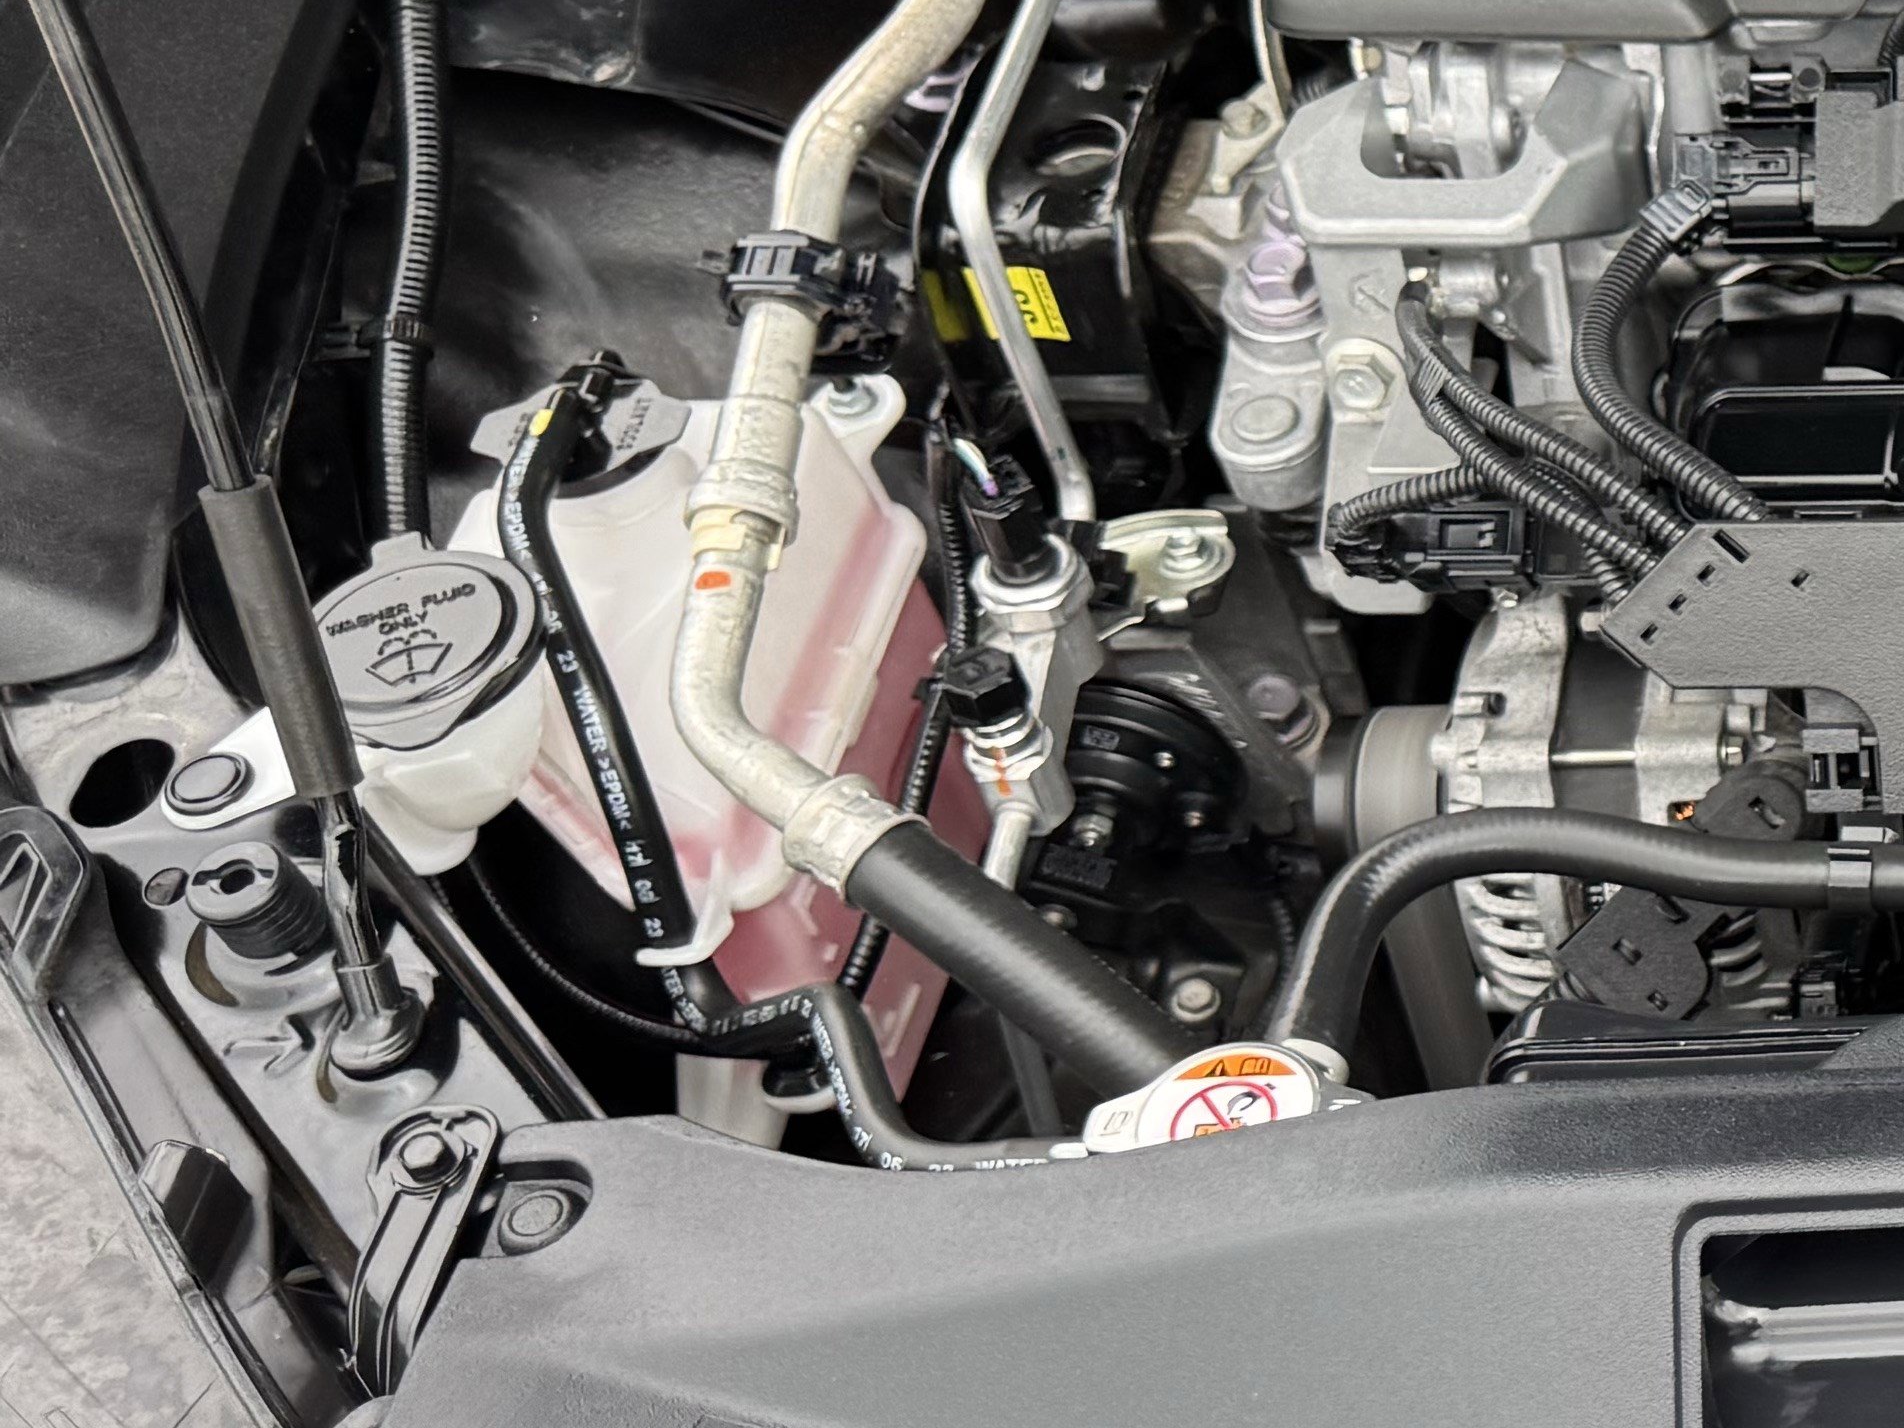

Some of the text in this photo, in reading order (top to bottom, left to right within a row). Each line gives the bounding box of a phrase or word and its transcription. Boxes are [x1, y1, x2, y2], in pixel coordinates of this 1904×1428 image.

[326, 582, 477, 637] WASHER FLUID
[379, 611, 429, 636] ONLY
[573, 684, 609, 754] WATER
